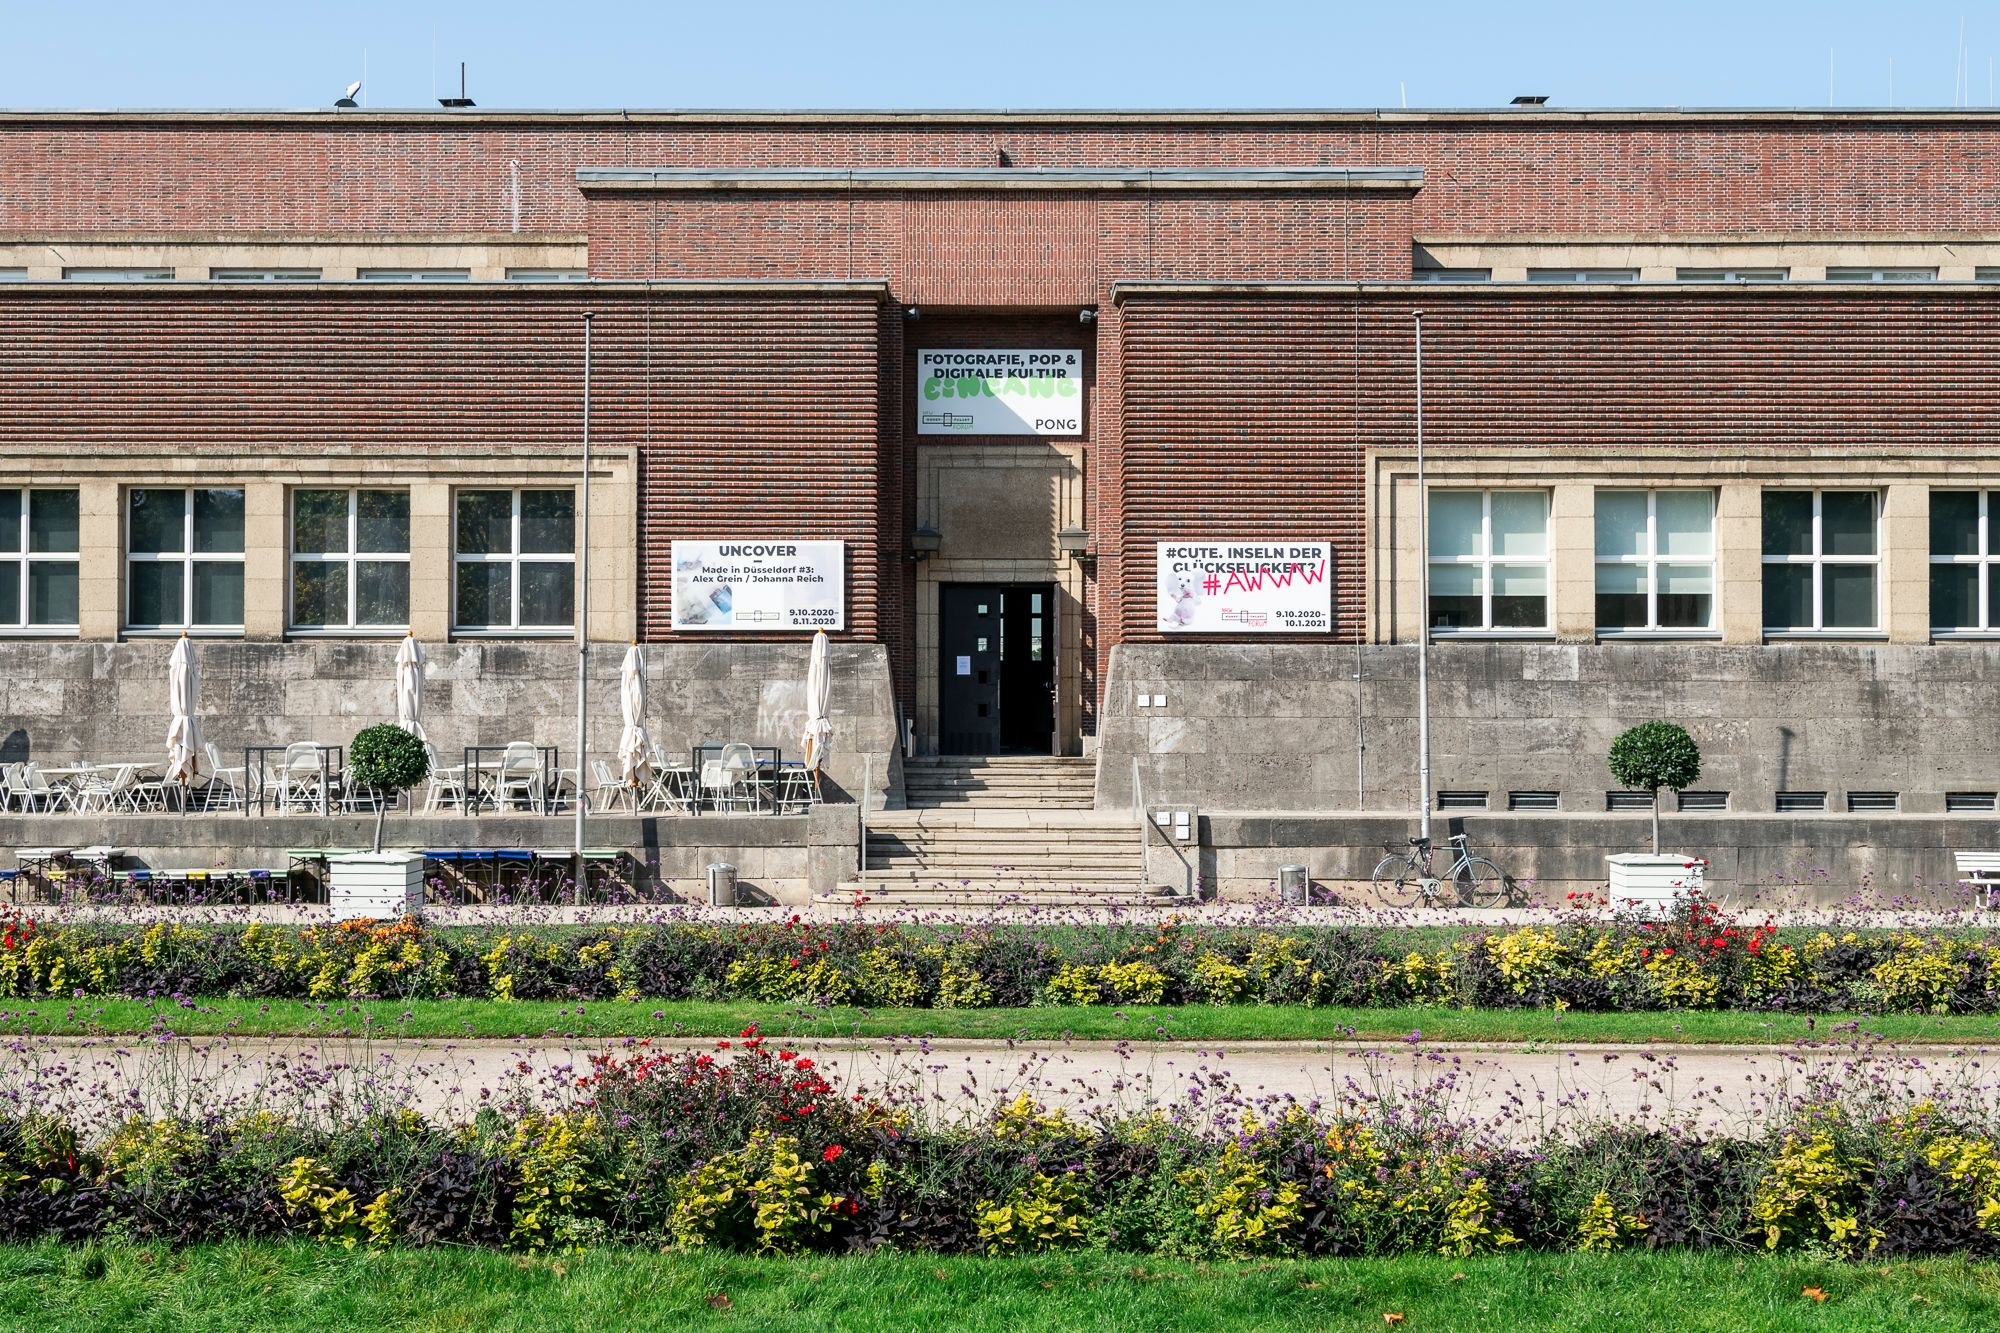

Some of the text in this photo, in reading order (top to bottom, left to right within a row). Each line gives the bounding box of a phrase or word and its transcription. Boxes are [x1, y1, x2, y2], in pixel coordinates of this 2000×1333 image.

[923, 354, 1076, 367] FOTOGRAFIE, POP &
[934, 368, 1067, 379] DIGITALE KULTUR
[1035, 419, 1077, 430] PONG
[719, 545, 797, 556] UNCOVER
[1166, 547, 1322, 559] #CUTE. INSELN DER
[702, 566, 814, 574] Made in Düsseldorf #3:
[692, 575, 714, 583] Alex
[717, 575, 743, 583] Grein
[752, 575, 794, 583] Johanna
[797, 575, 824, 583] Reich
